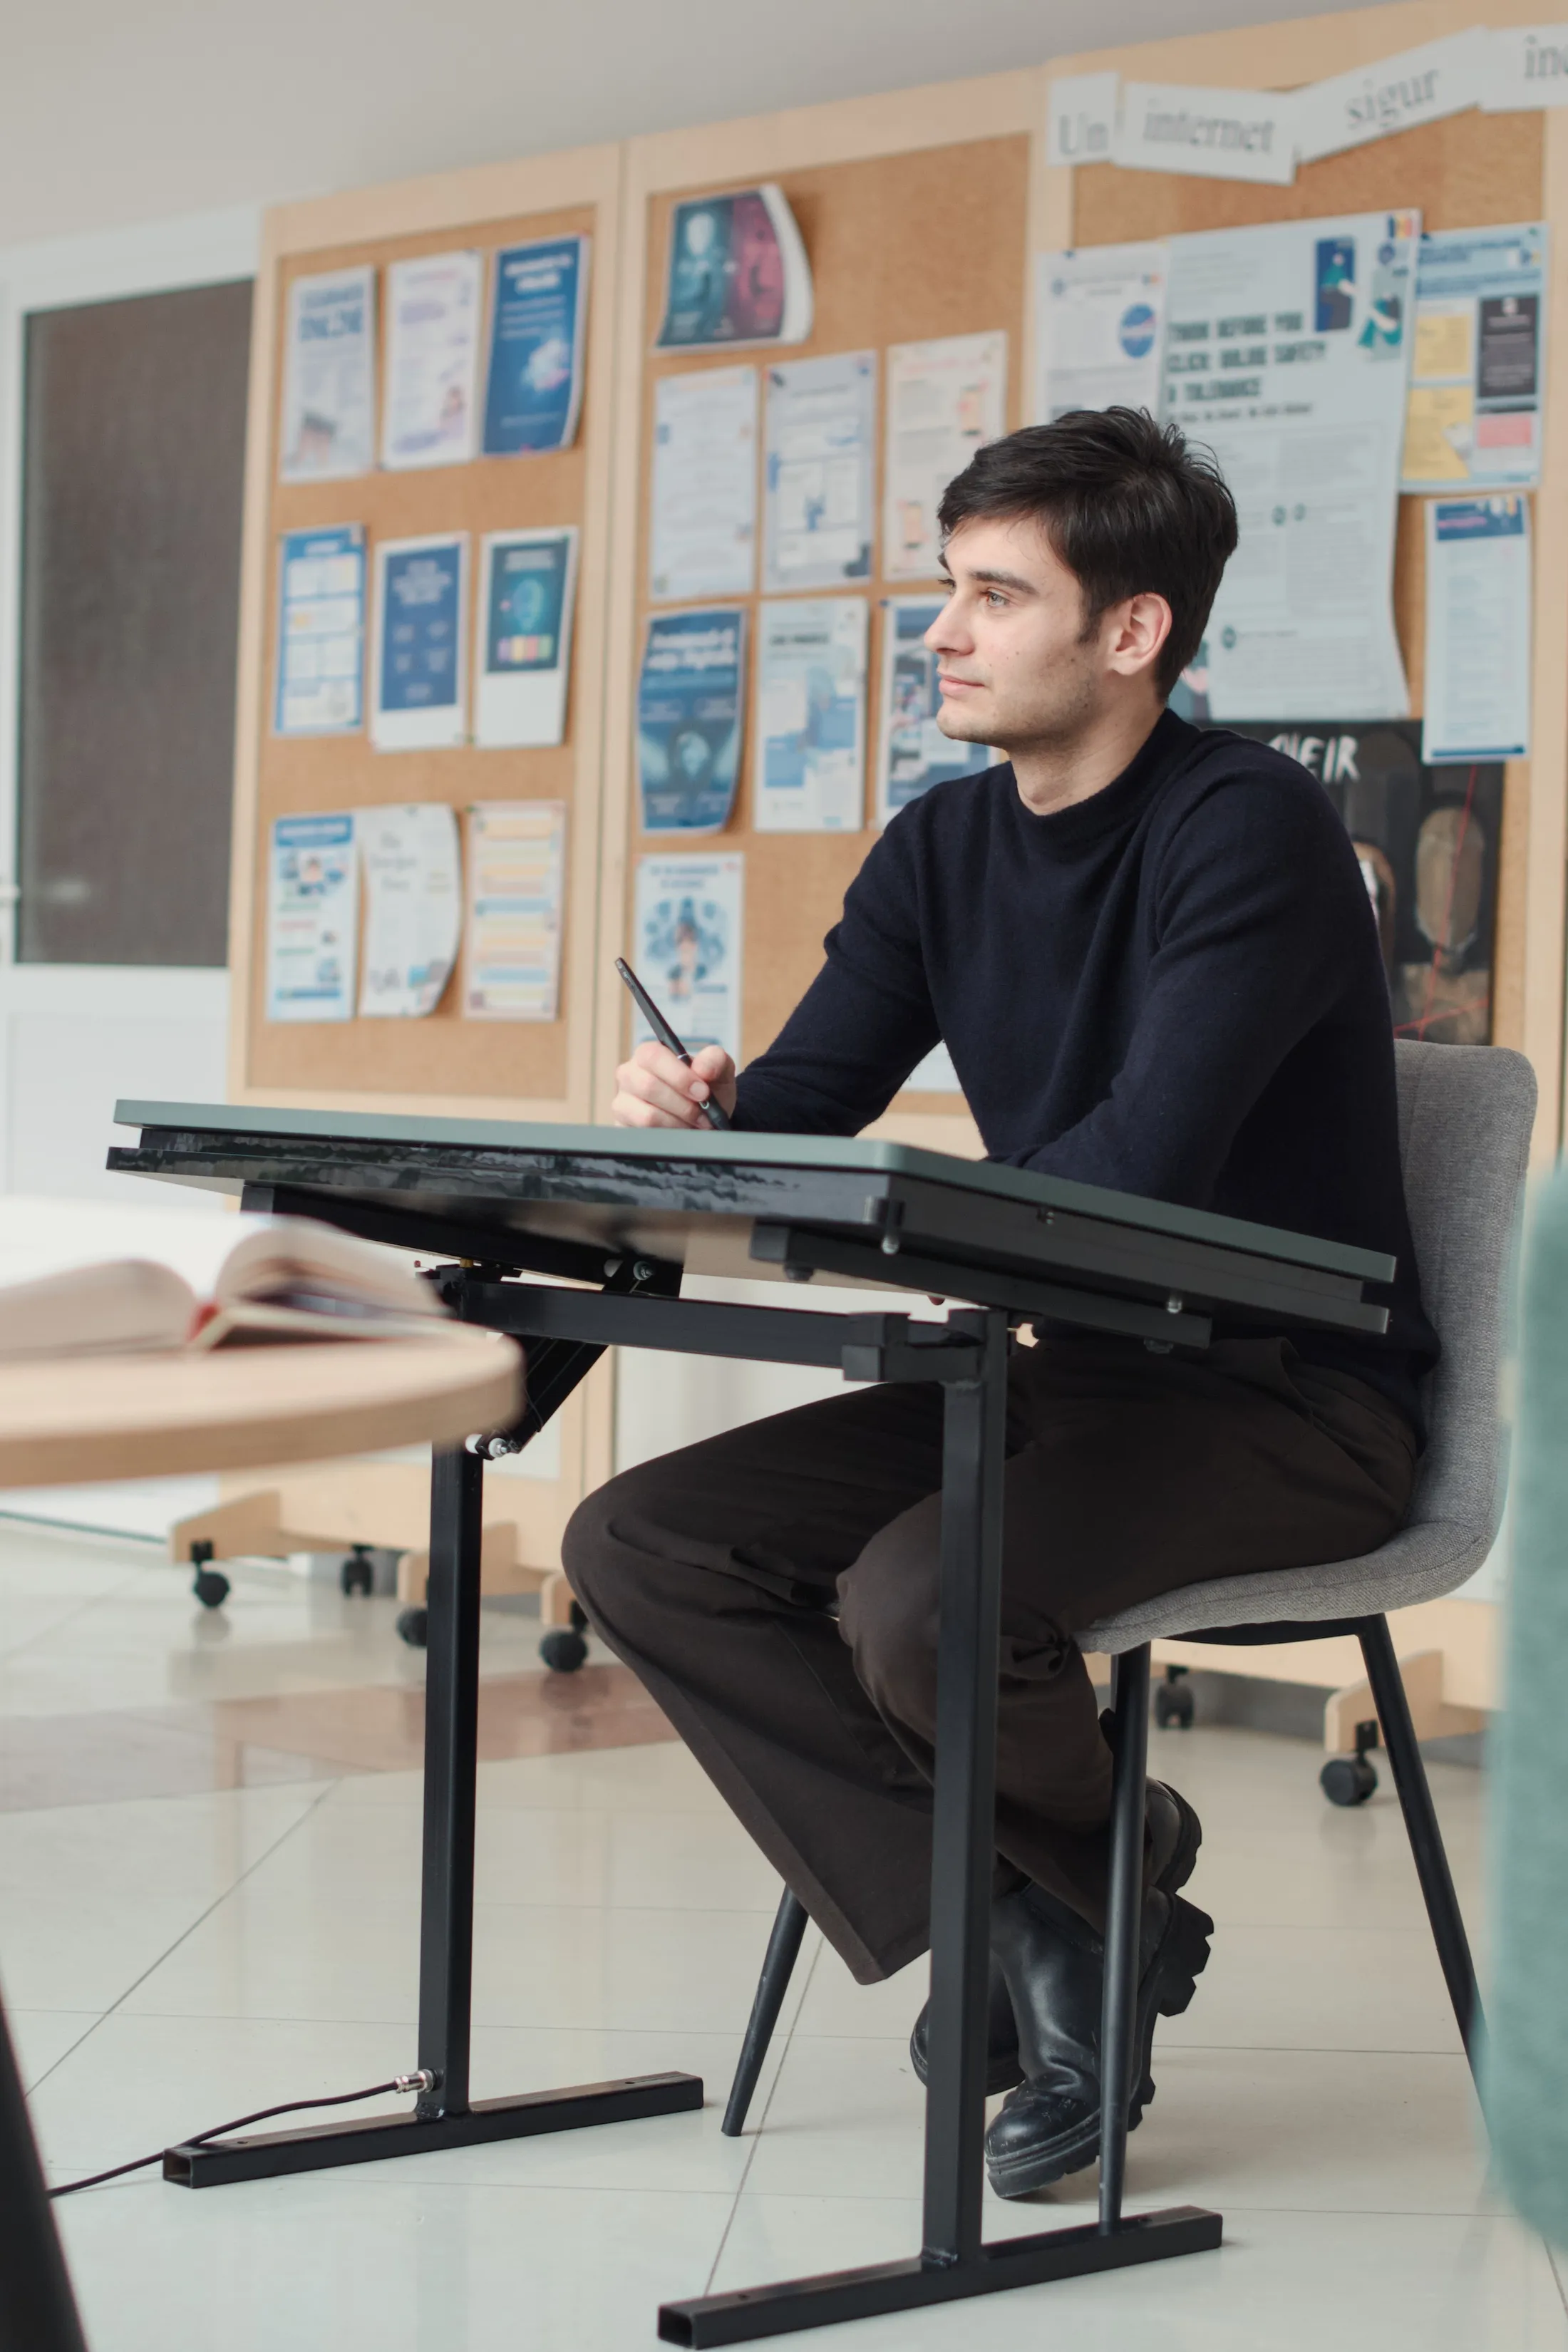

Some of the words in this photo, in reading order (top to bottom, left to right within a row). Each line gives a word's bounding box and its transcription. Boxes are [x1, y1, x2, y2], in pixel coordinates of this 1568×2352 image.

[1058, 110, 1108, 155] Un
[1142, 98, 1275, 156] internet
[1343, 68, 1440, 133] sigur
[1218, 315, 1266, 338] BEFORE
[1276, 340, 1326, 363] SAFETY
